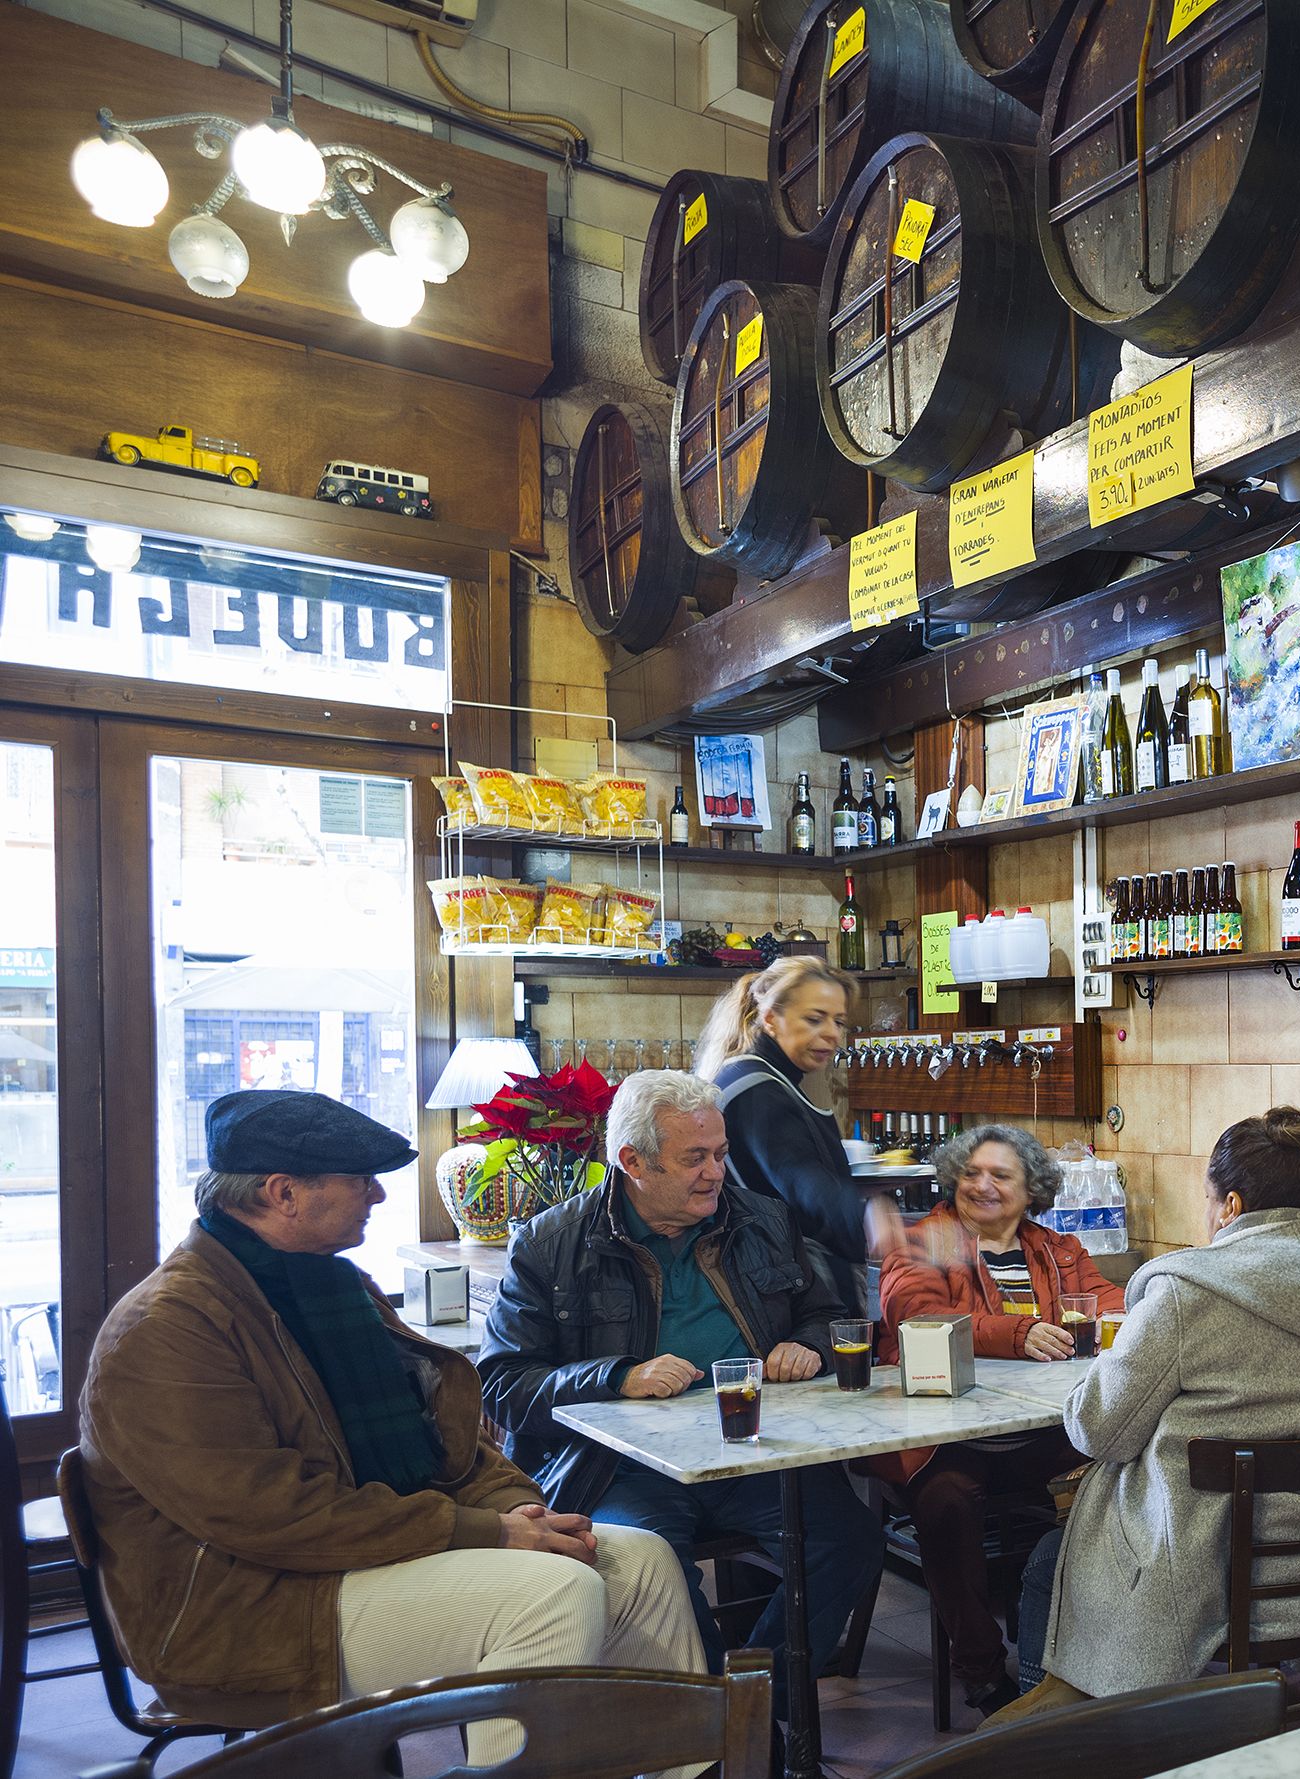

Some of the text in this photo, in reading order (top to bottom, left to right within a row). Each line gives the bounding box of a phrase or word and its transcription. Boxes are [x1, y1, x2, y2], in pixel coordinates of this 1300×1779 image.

[1092, 391, 1162, 434] MONTADITOS
[1094, 404, 1182, 460] FETS AL MOMENT
[1090, 435, 1174, 483] PER COMPARTIR
[952, 468, 1019, 506] GRAN VARIETAT
[955, 498, 1005, 525] D'ENTREPANS
[851, 551, 876, 568] VERMUT
[903, 538, 911, 547] TU
[852, 524, 906, 553] PEL MOMENT DEL
[851, 570, 914, 601] COMBINAT DE LA CASA
[607, 780, 646, 791] TORRES
[616, 892, 656, 909] TORRES
[923, 922, 950, 938] BOSSES
[930, 944, 939, 954] DE
